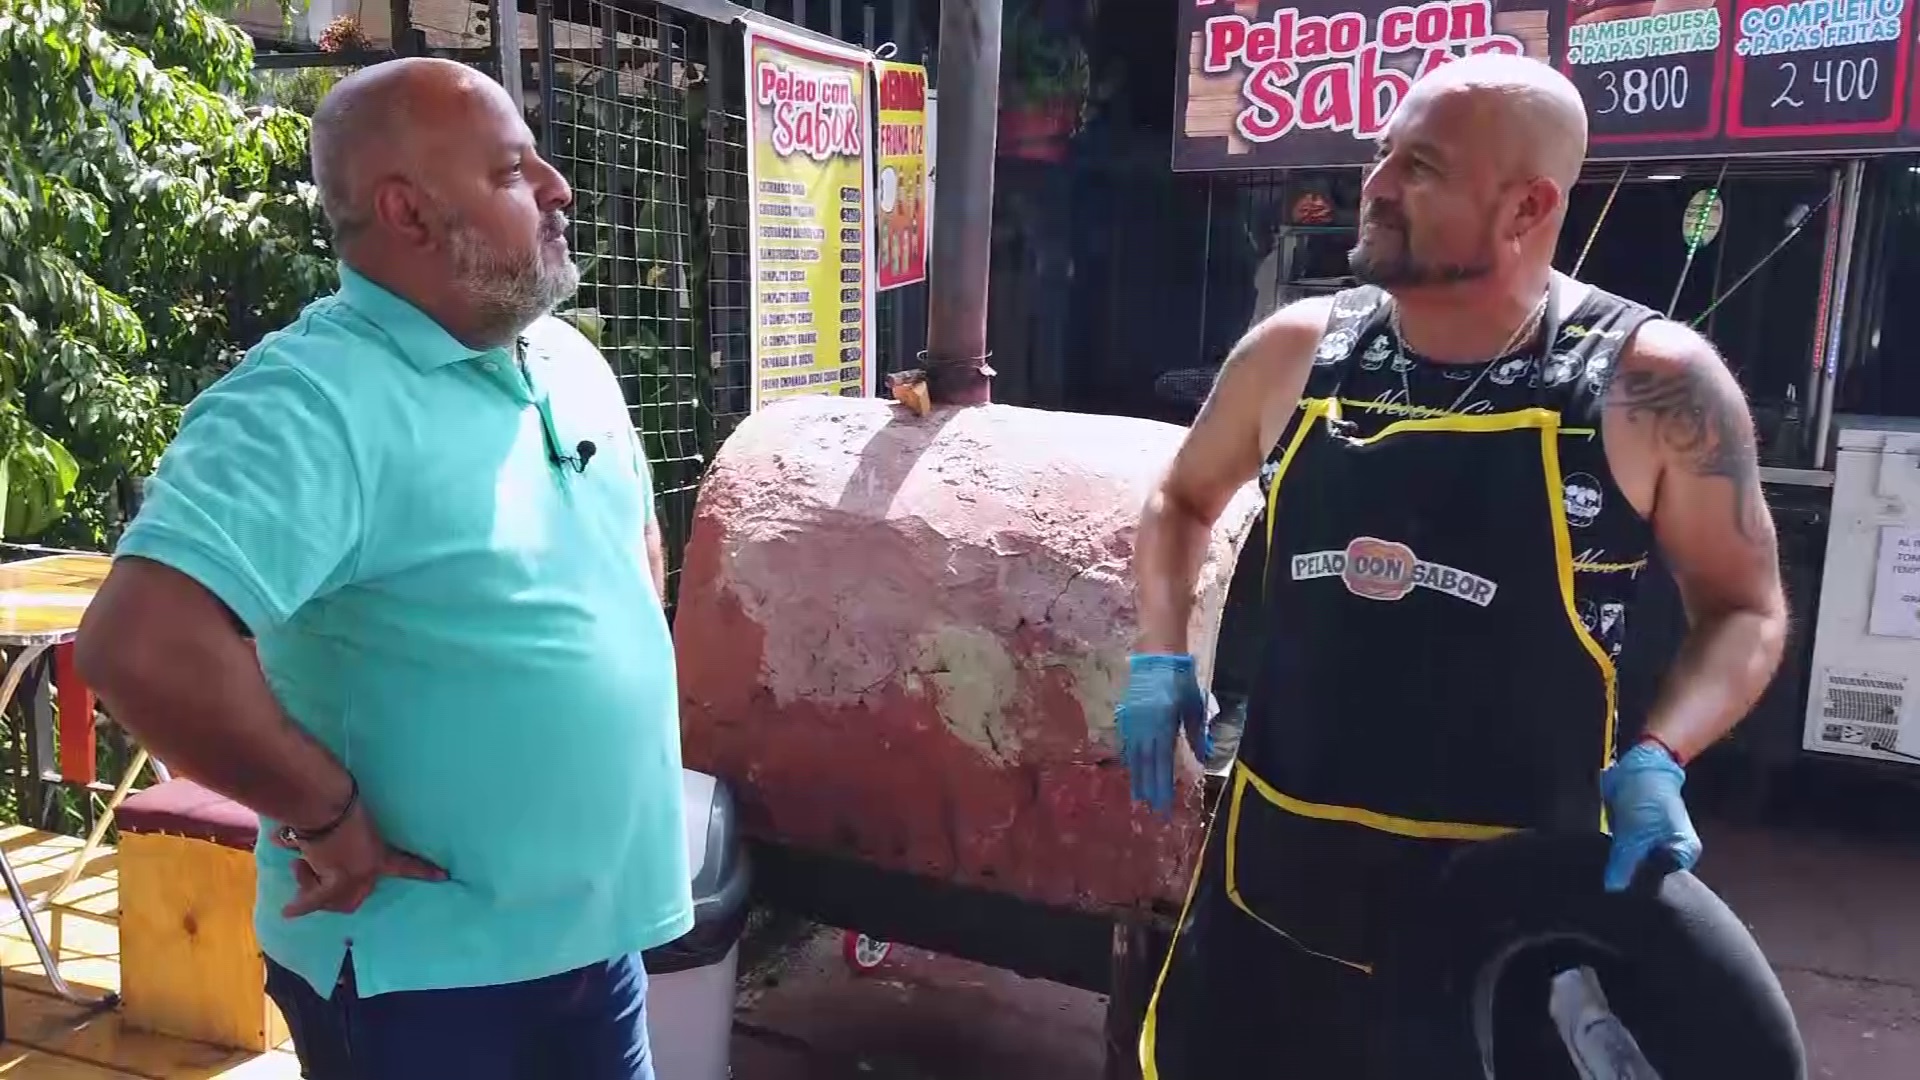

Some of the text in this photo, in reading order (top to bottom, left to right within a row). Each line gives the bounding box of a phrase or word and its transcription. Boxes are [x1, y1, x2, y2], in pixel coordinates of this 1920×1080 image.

[1207, 2, 1487, 68] Pelao con
[1570, 11, 1719, 44] HAMBURGUESA
[1742, 0, 1901, 34] COMPLETO
[1824, 18, 1898, 48] FRITAS
[1649, 31, 1719, 55] FRITAS
[761, 67, 850, 105] Pelao con
[1596, 65, 1689, 115] 3800
[1294, 554, 1492, 603] PELAO CON SABOR
